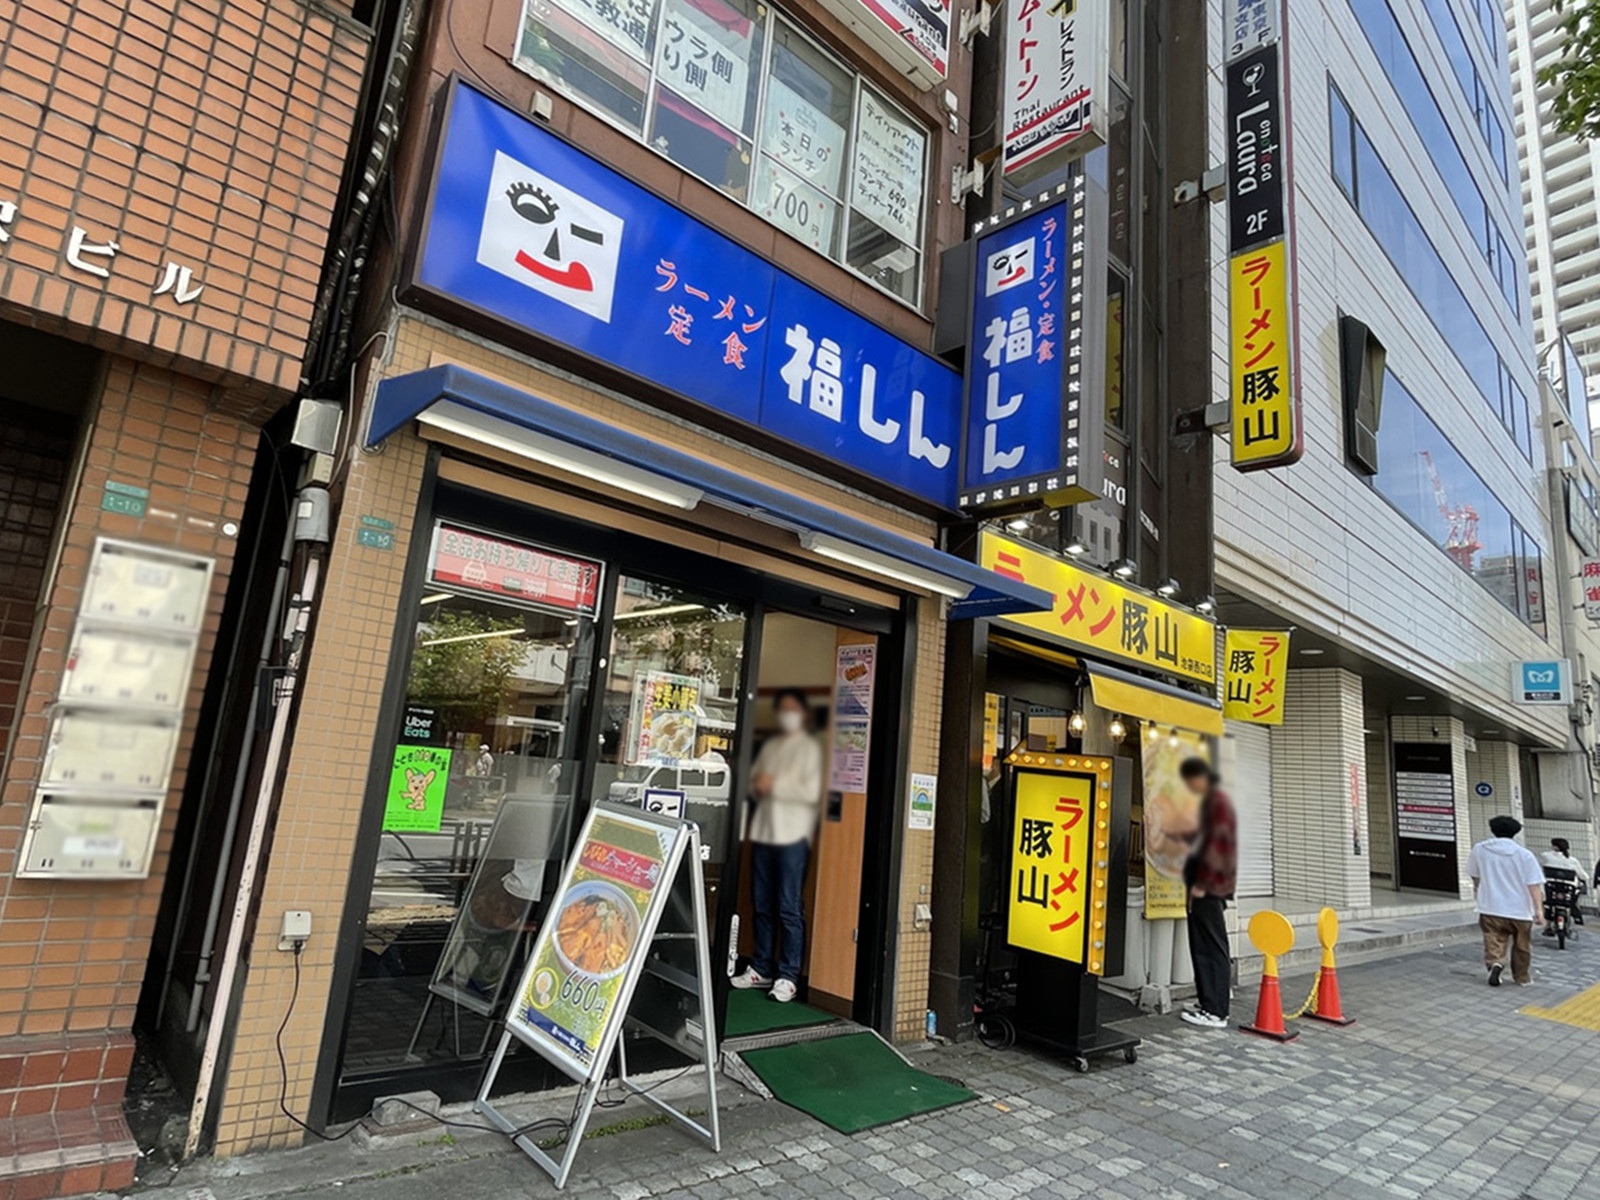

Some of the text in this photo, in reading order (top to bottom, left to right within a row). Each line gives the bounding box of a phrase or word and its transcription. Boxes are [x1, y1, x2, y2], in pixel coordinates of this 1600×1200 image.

[664, 45, 708, 91] り側
[665, 18, 734, 84] ウラ側
[1060, 20, 1075, 90] レストラン
[780, 120, 828, 163] 本日の
[1014, 99, 1040, 120] Thai
[779, 139, 816, 172] ランチ
[1236, 100, 1270, 196] Laura
[1259, 119, 1278, 182] enoteca
[1246, 209, 1269, 235] 2F
[655, 258, 767, 334] ラーメン
[664, 304, 749, 370] 定食
[780, 323, 951, 469] 福しん
[982, 306, 1034, 475] 福しん
[443, 531, 596, 586] 全品お持ち帰りできます
[993, 551, 1178, 666] ラメン豚山
[1227, 650, 1256, 705] 豚山
[1252, 635, 1281, 719] ラーメン
[404, 726, 430, 738] Eats
[405, 715, 433, 728] Uber
[1017, 818, 1054, 910] 豚山
[1049, 797, 1084, 933] ラーメン
